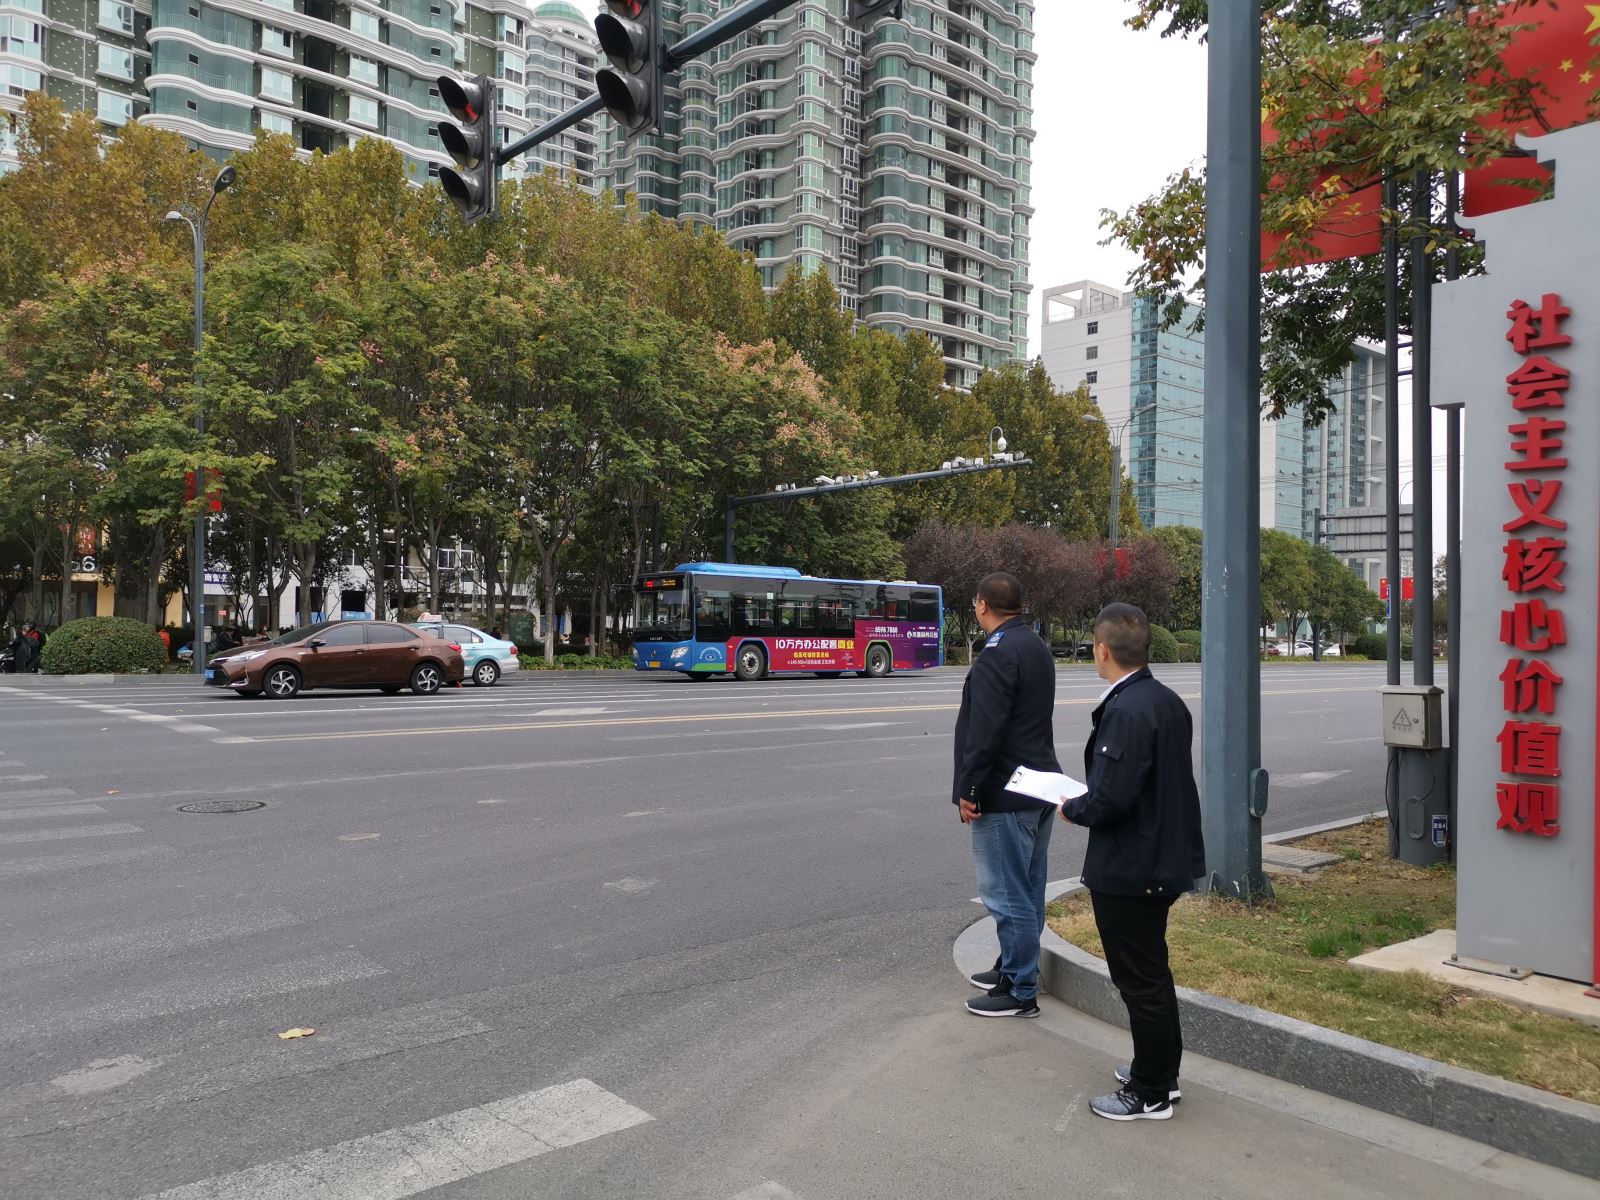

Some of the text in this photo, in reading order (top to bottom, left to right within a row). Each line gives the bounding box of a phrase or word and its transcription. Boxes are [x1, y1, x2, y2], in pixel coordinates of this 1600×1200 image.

[1496, 293, 1572, 837] 社会主义核心价值观
